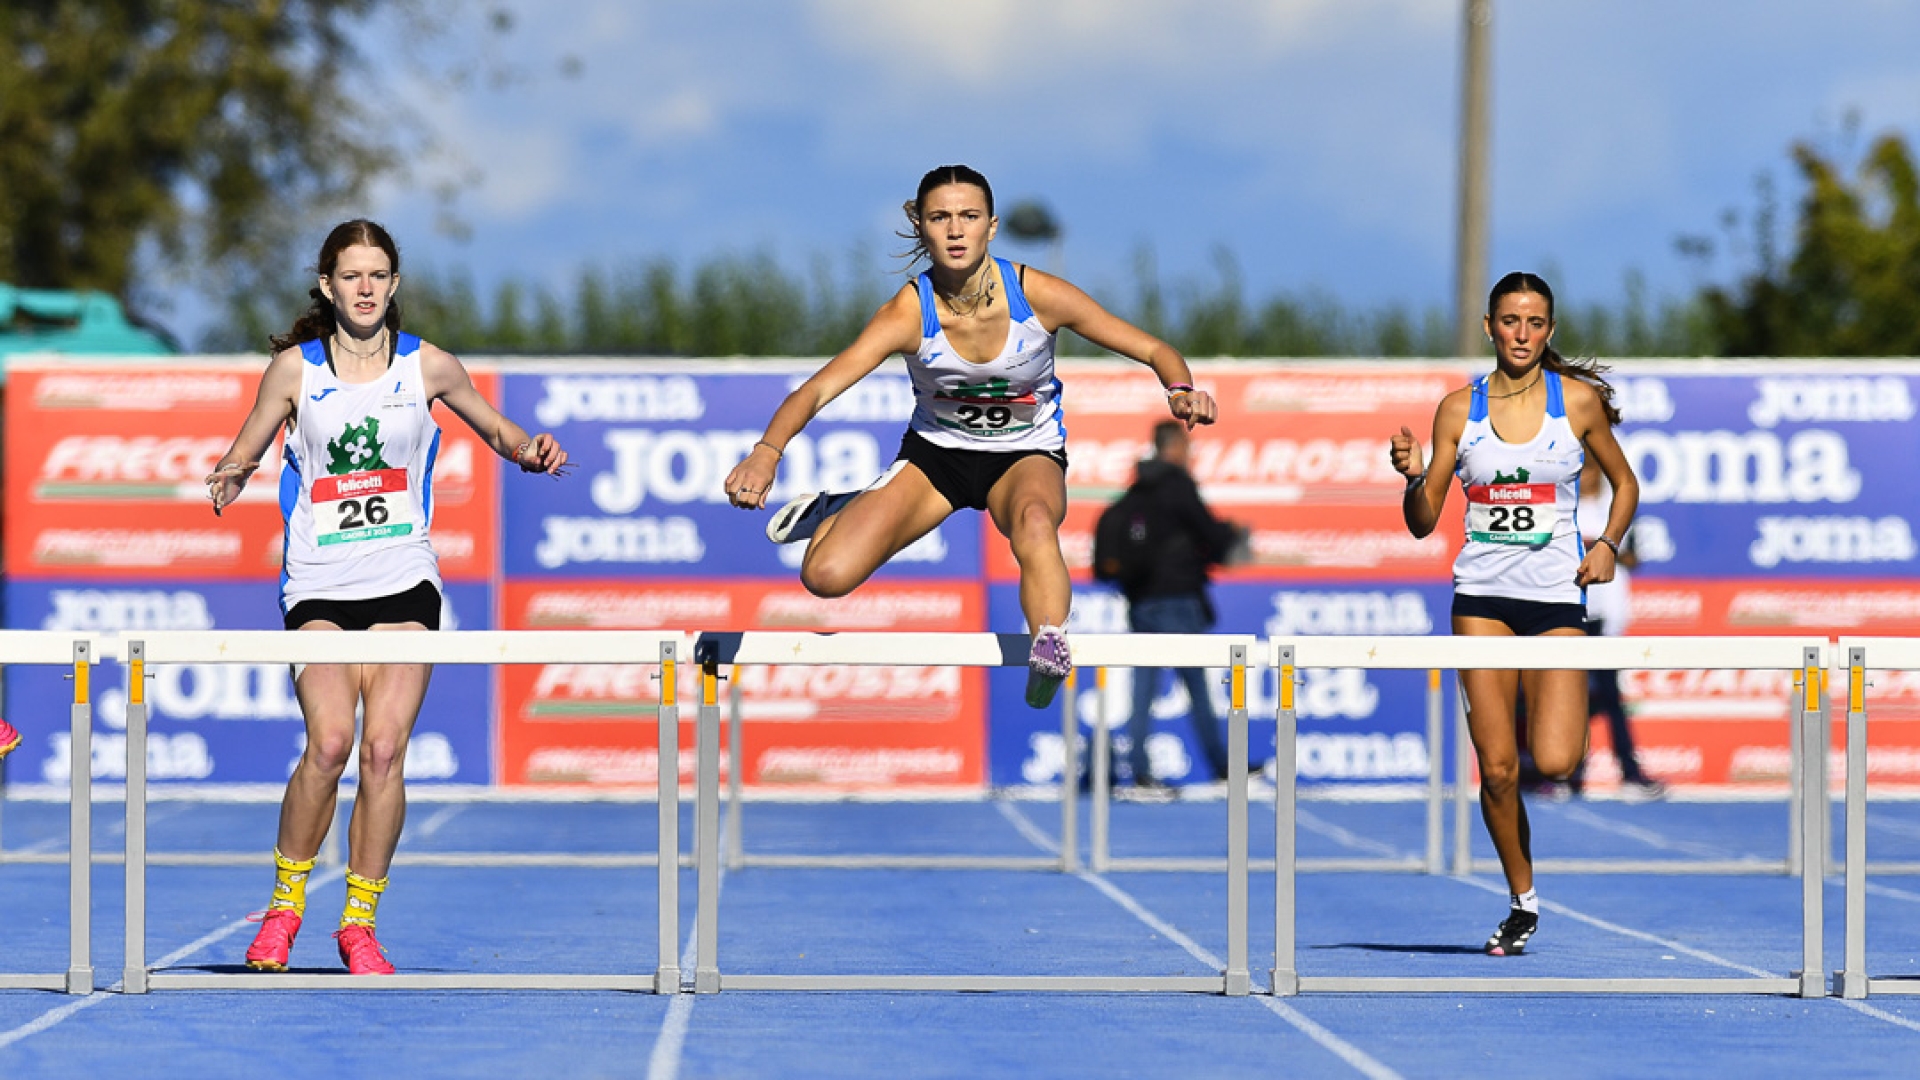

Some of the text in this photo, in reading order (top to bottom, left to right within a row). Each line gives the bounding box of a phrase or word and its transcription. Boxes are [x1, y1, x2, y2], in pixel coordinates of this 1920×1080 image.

[956, 404, 1011, 428] 29
[1616, 428, 1863, 503] oma
[337, 495, 388, 530] 26
[1488, 506, 1536, 531] 28
